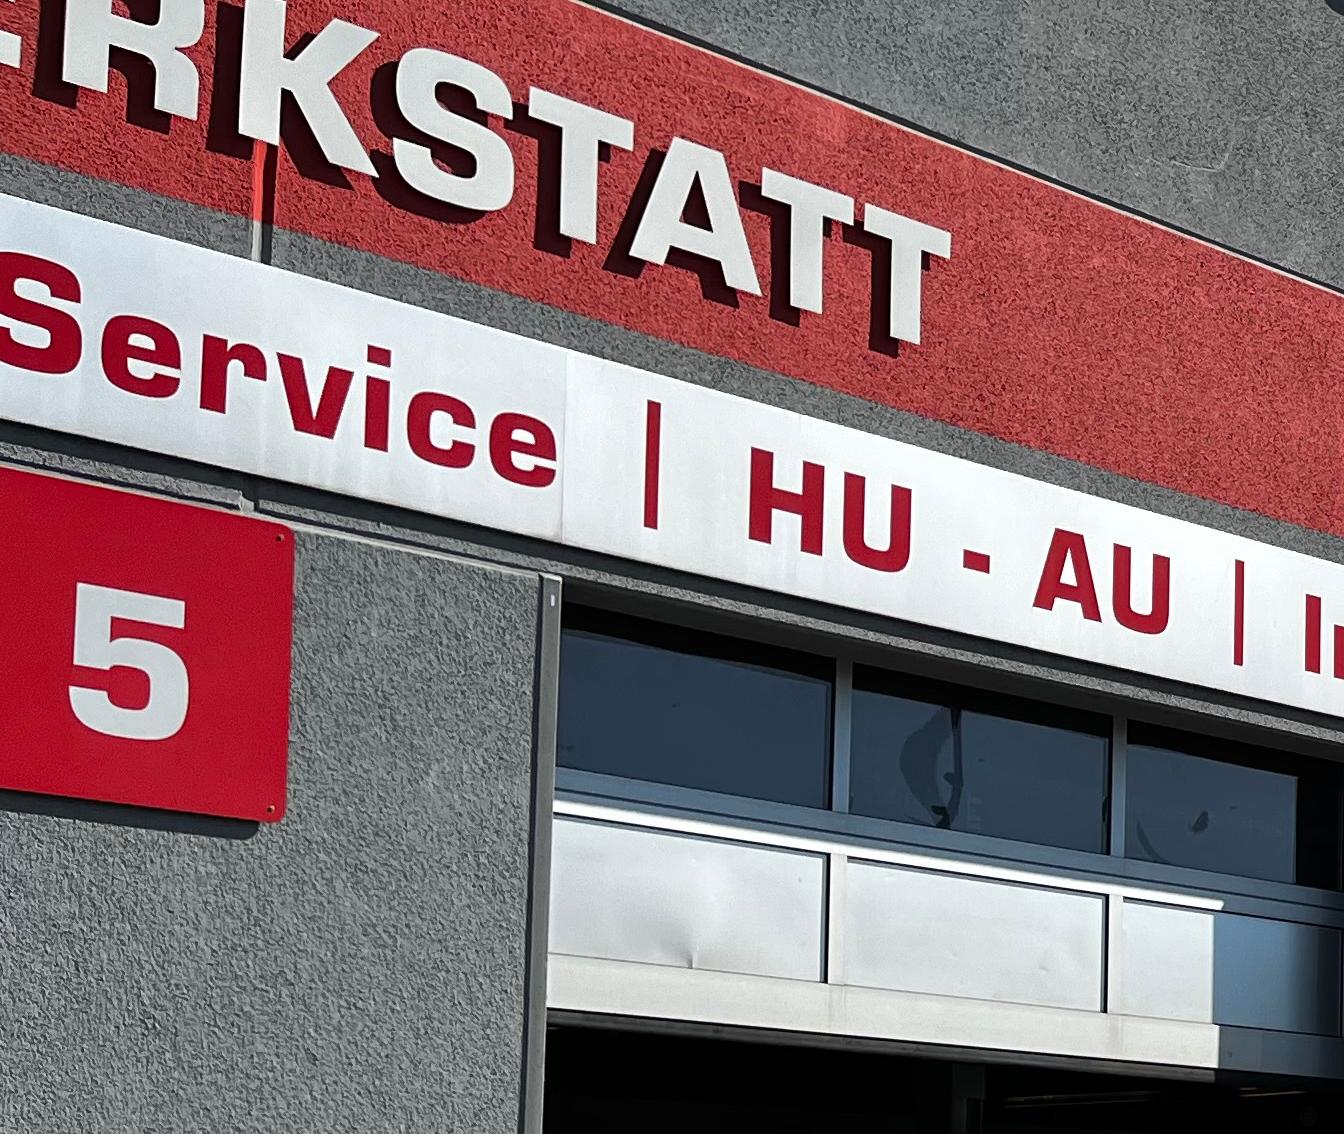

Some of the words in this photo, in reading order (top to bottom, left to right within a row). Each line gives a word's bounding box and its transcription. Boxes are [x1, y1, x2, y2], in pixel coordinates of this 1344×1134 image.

[0, 0, 951, 345] RKSTATT
[0, 251, 557, 488] Service
[749, 447, 913, 573] HU
[1034, 529, 1171, 635] AU
[68, 582, 189, 740] 5
